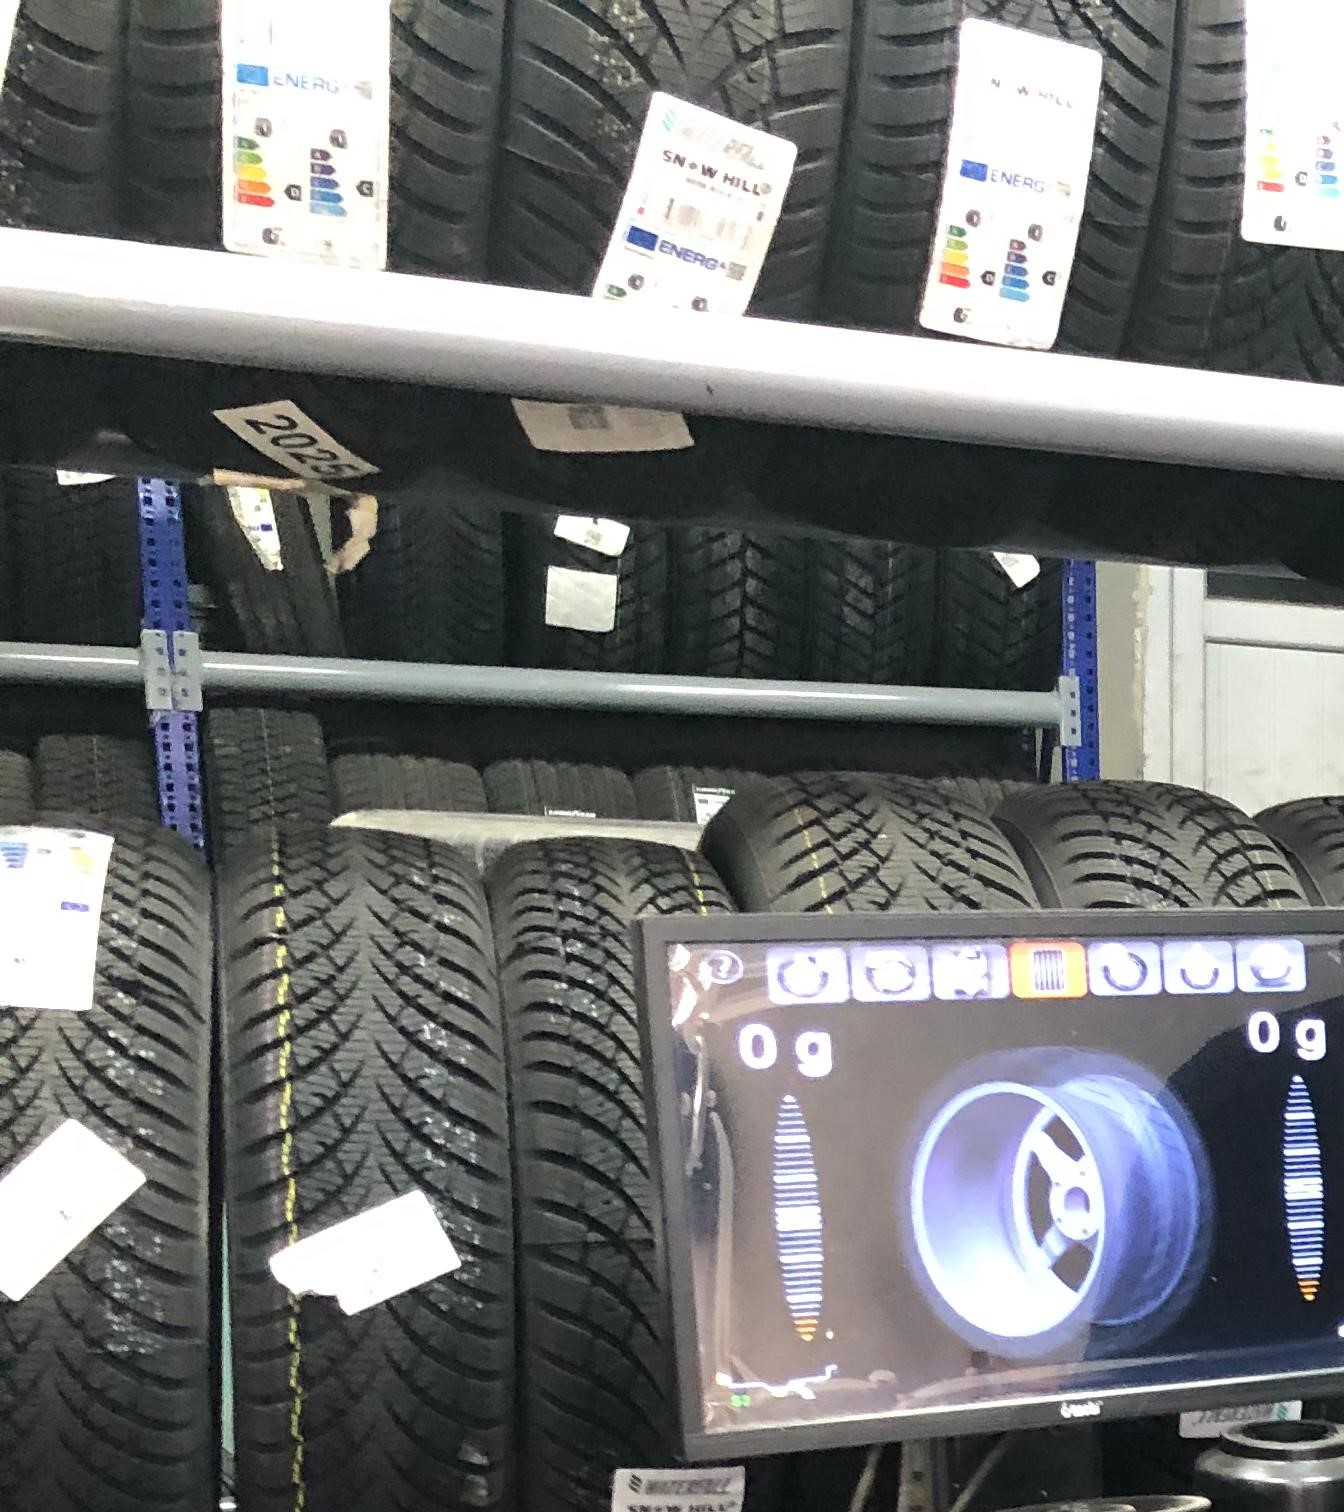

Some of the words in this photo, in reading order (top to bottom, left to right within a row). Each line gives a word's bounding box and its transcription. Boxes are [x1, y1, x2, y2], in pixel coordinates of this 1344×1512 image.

[722, 172, 761, 197] HILL
[990, 169, 1046, 194] ENERG
[658, 239, 720, 271] ENERG
[739, 1022, 778, 1070] 0
[794, 1030, 833, 1078] g
[1247, 1011, 1281, 1053] 0
[1294, 1018, 1327, 1062] g
